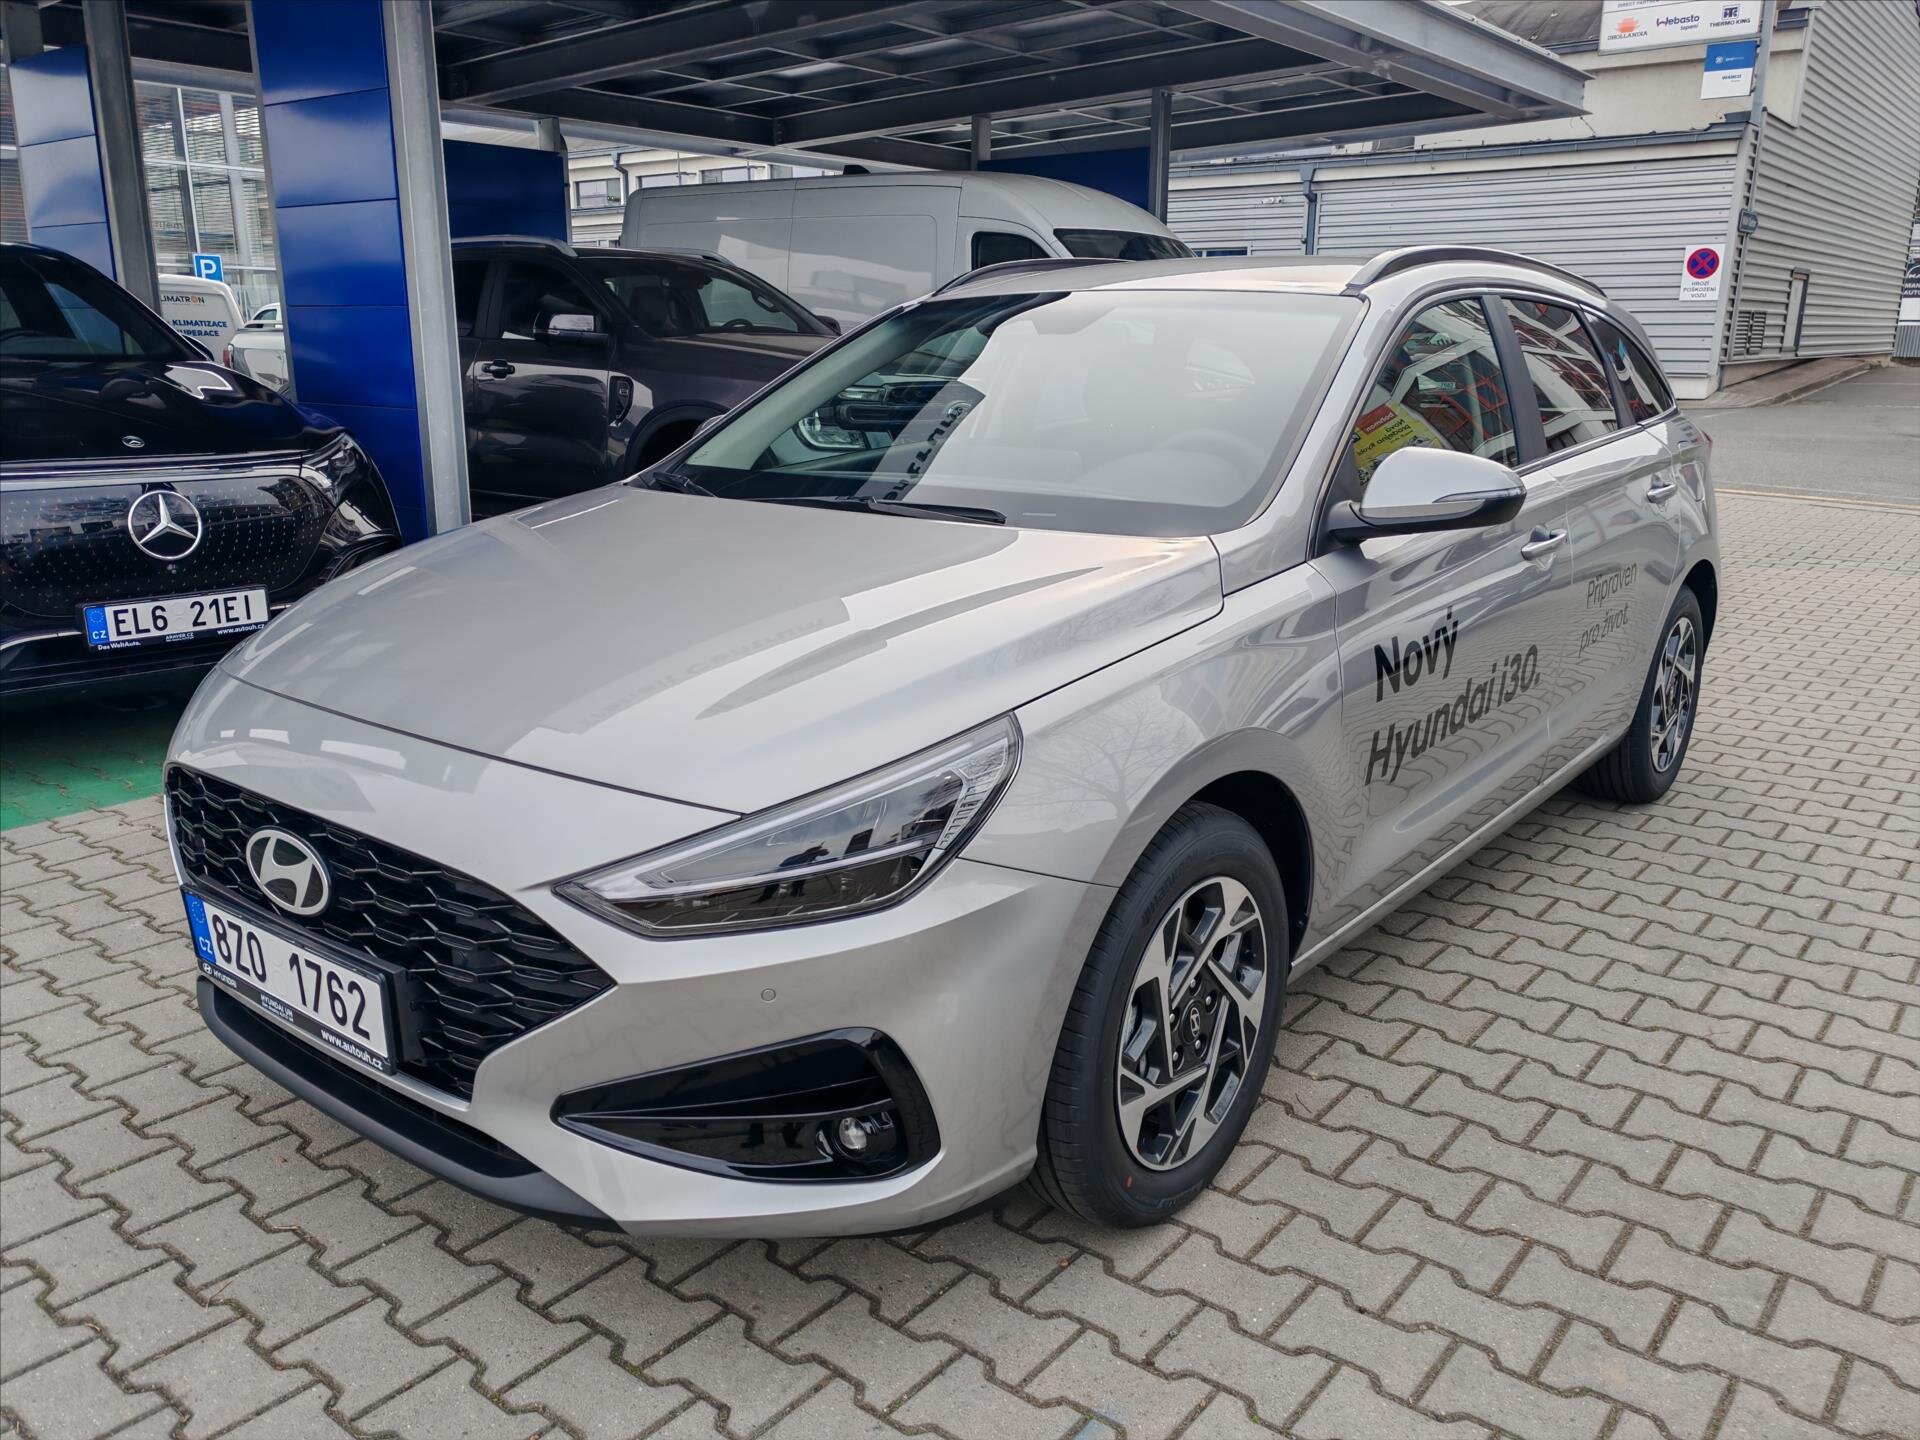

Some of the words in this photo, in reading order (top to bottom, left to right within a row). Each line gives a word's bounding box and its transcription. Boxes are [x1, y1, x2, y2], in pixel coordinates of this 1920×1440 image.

[1656, 14, 1700, 26] Webasto
[1709, 20, 1735, 28] THERMO
[200, 259, 217, 280] P
[172, 320, 227, 328] KLIMATIZACE
[1586, 563, 1637, 609] Připraven
[112, 605, 169, 637] EL6
[190, 594, 251, 627] 21EI
[92, 630, 107, 640] CZ
[217, 623, 265, 635] www.autouh.cz
[98, 643, 110, 651] Das
[1578, 623, 1600, 659] pro
[1373, 605, 1459, 703] Nový
[1365, 662, 1497, 786] Hyundai
[199, 936, 214, 954] CZ
[289, 953, 370, 1040] 1762
[320, 1029, 384, 1070] www.autouh.cz
